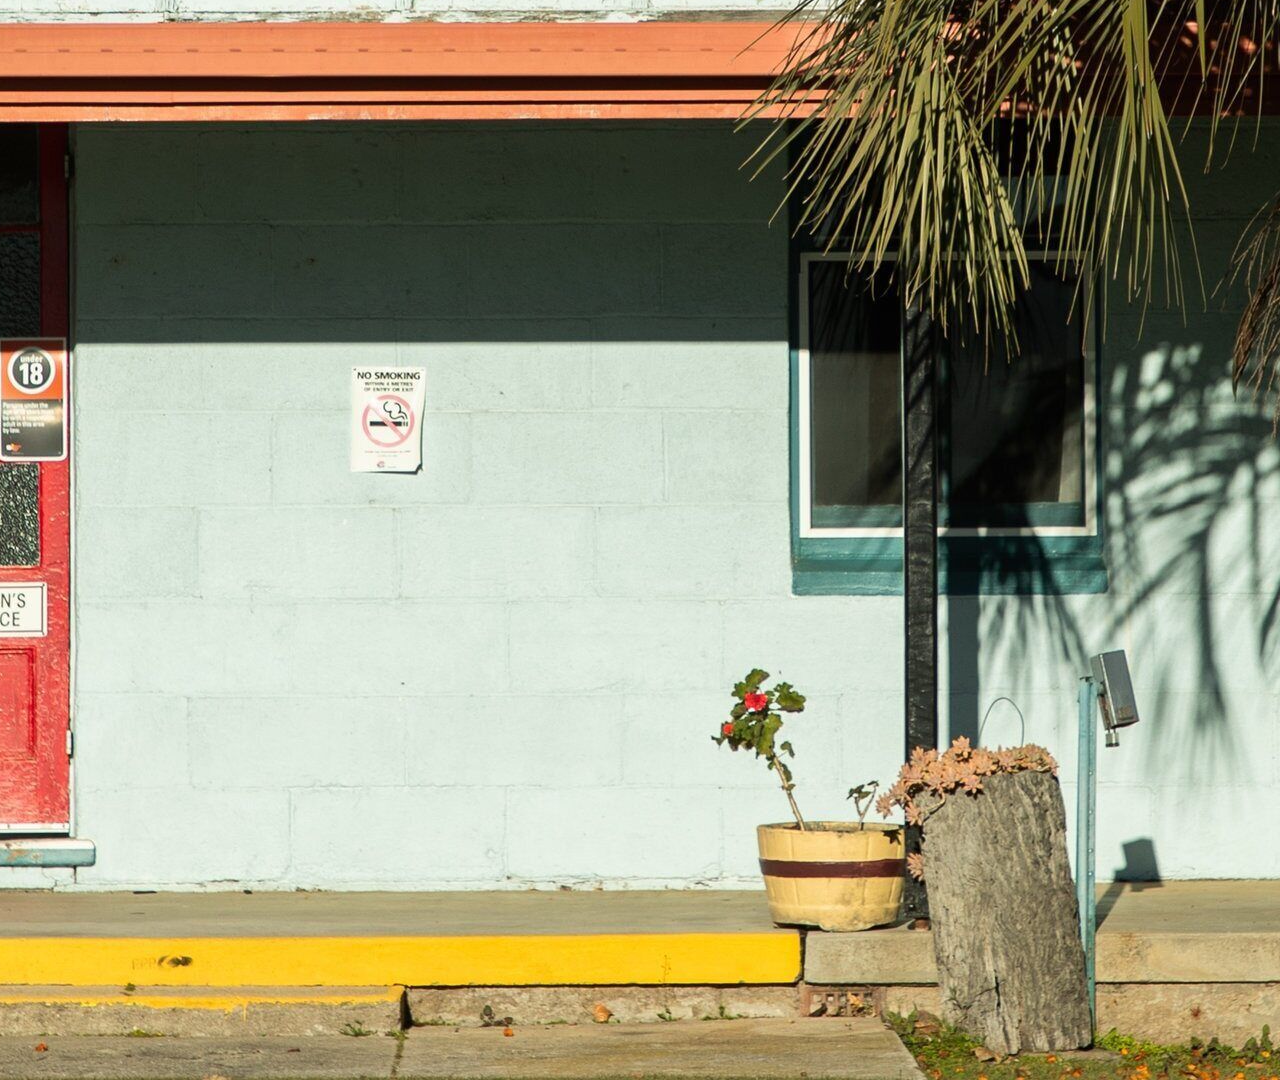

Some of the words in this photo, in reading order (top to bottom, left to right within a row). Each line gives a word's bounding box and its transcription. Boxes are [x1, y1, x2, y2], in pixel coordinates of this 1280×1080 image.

[21, 354, 43, 363] under
[20, 362, 43, 385] 18
[357, 372, 372, 380] NO
[375, 372, 421, 380] SMOKING
